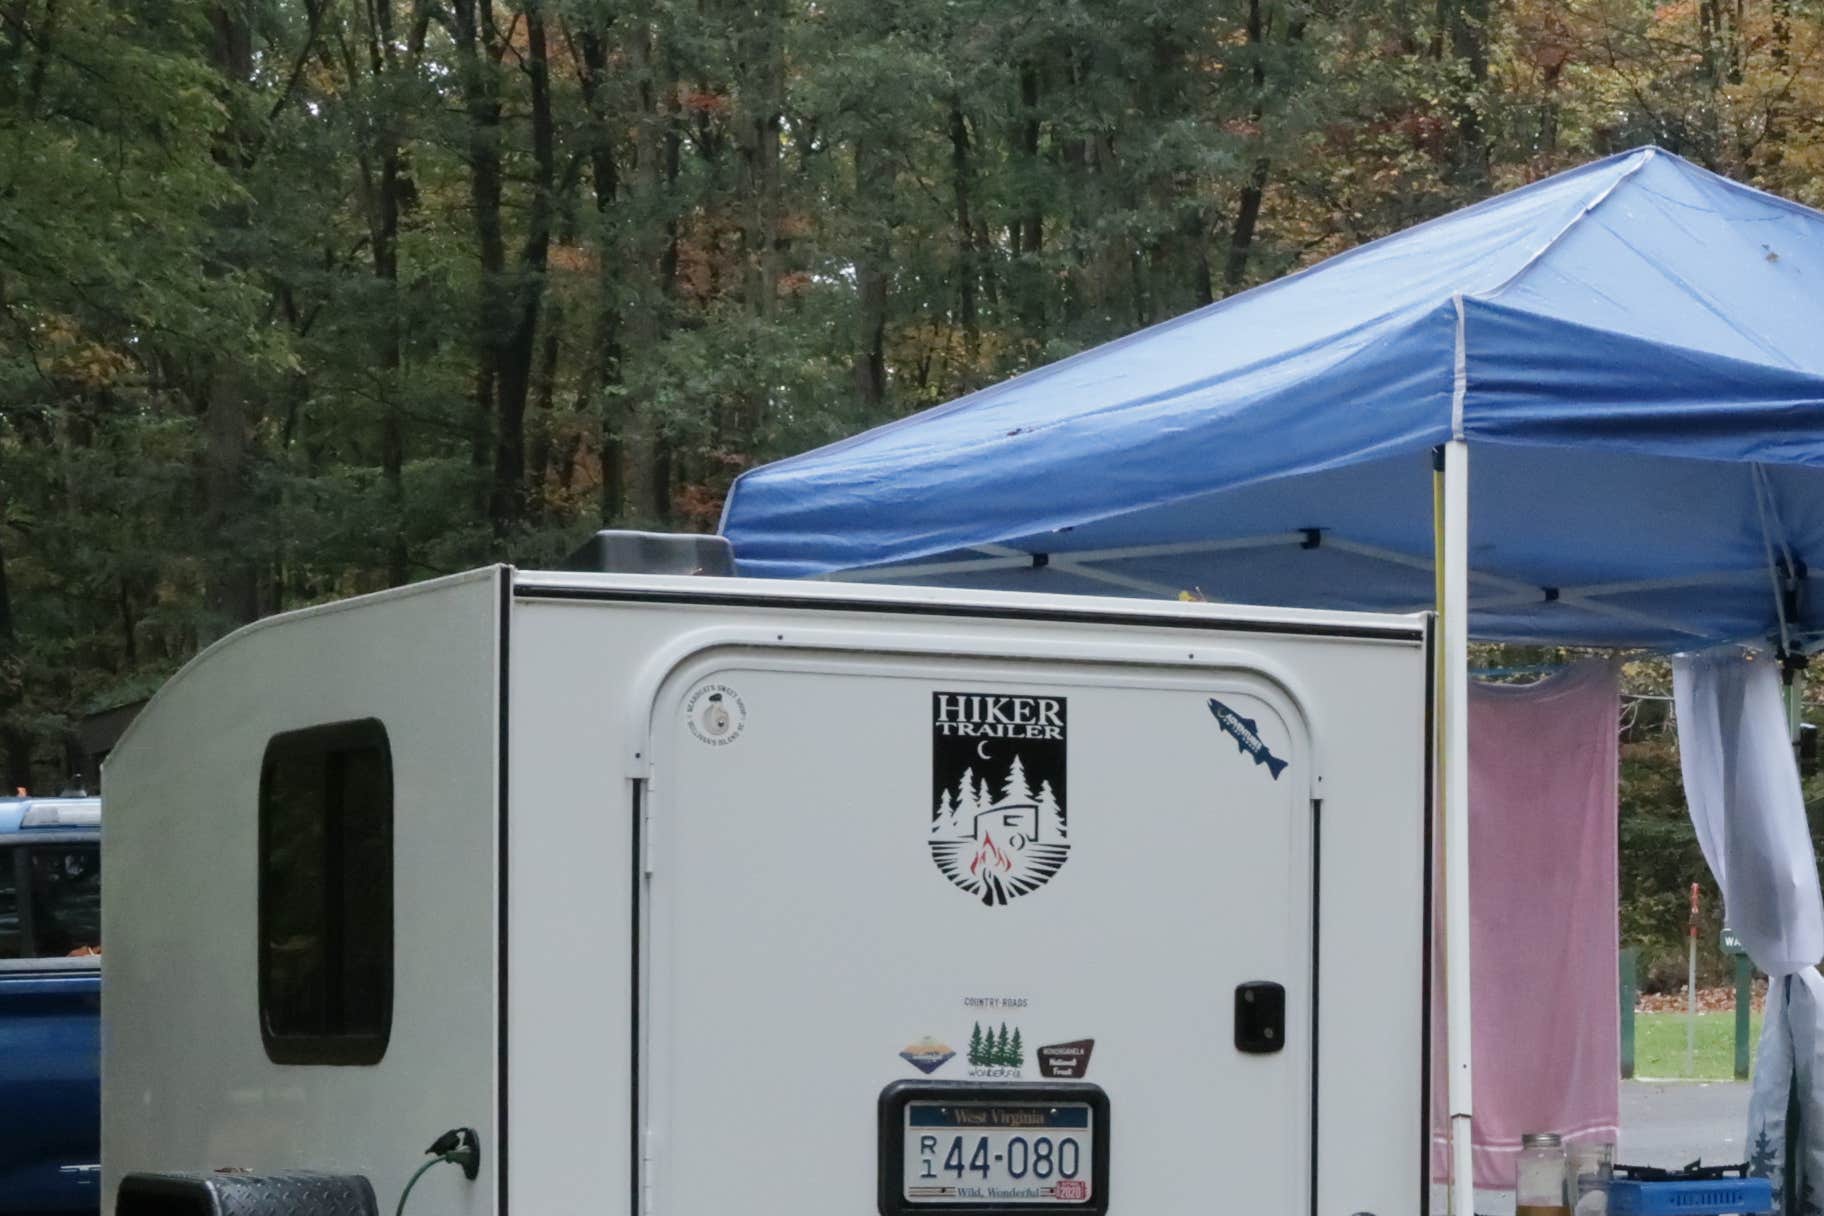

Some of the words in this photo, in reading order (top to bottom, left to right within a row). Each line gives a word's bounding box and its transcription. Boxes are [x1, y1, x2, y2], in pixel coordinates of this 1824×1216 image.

[937, 694, 1064, 726] HIKER
[935, 721, 1064, 740] TRAILER
[963, 996, 1000, 1008] COUNTRY
[954, 1109, 986, 1123] West
[990, 1109, 1045, 1126] Virginia
[943, 1135, 1080, 1180] 44-080
[957, 1187, 984, 1199] Wild,
[987, 1187, 1040, 1198] Wonderful
